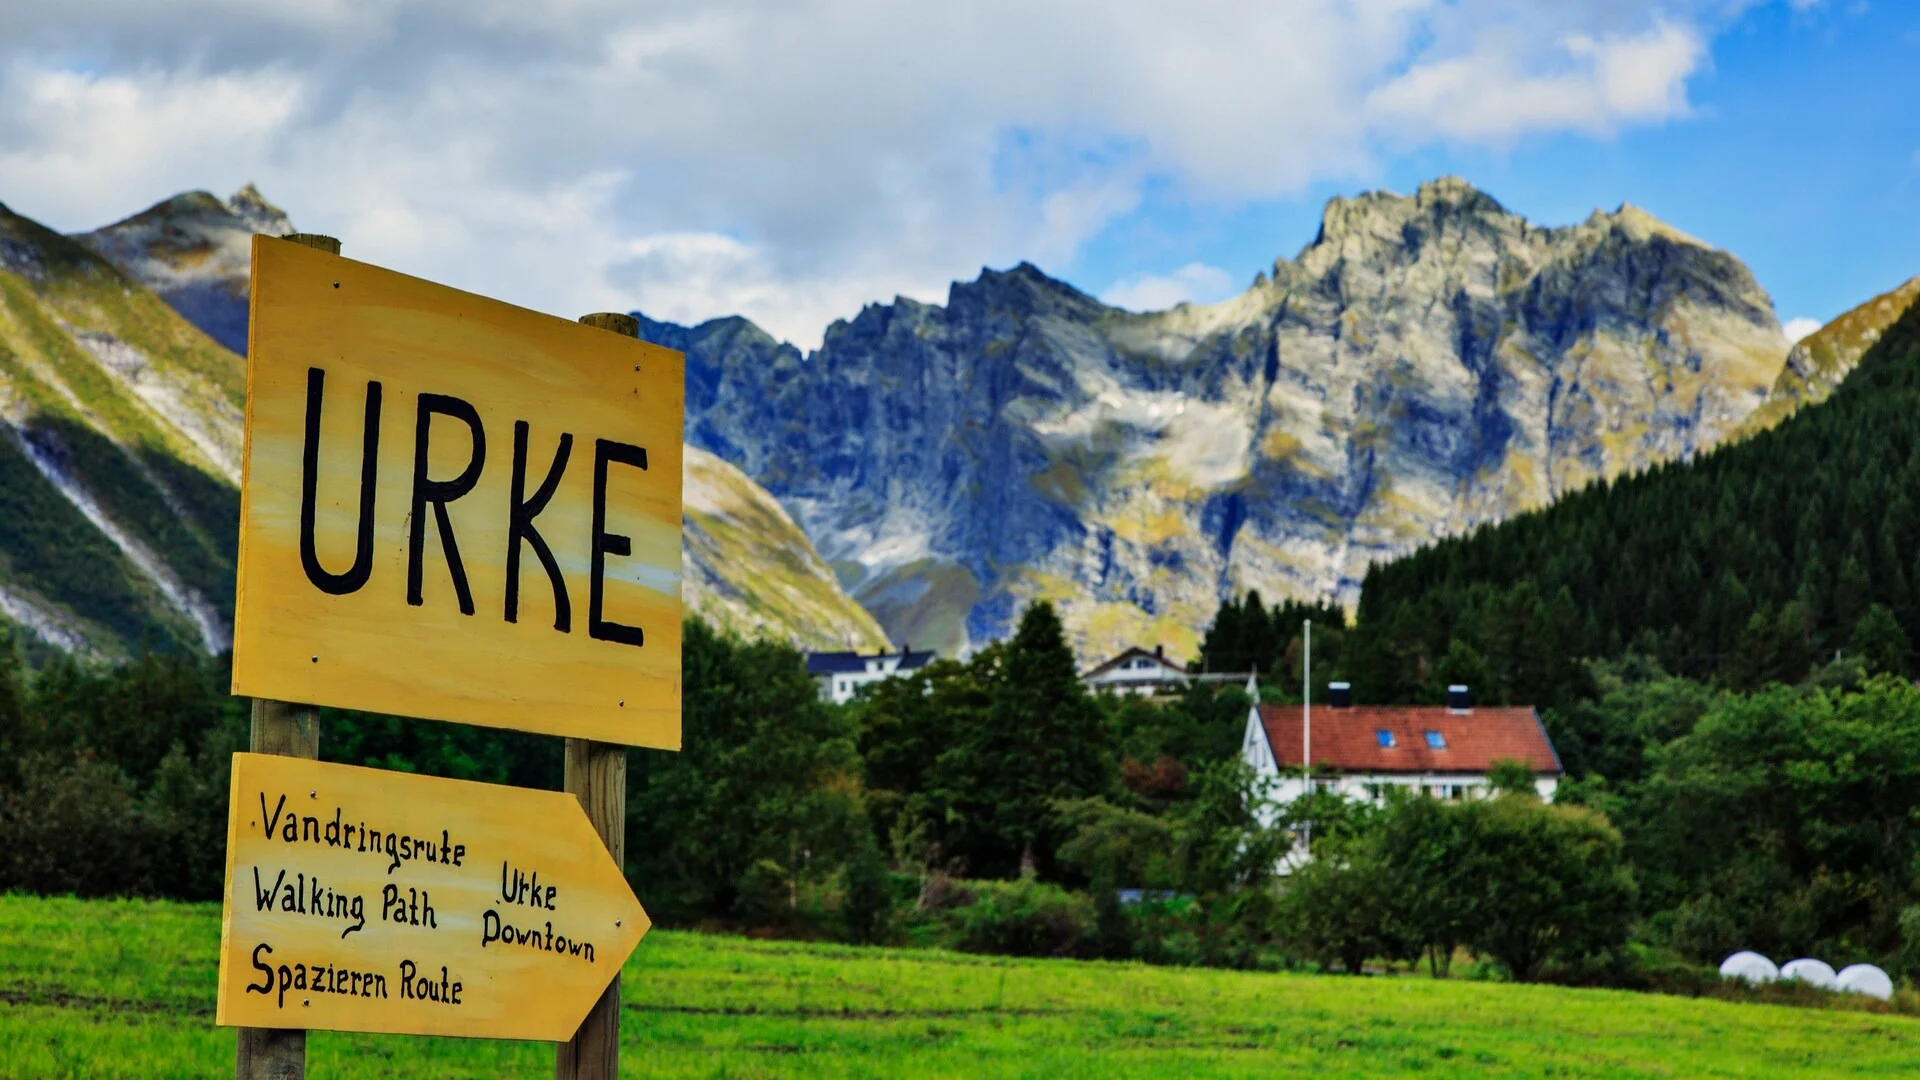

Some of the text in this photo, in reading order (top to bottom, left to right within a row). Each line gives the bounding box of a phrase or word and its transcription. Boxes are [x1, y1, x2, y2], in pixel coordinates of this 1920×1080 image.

[299, 366, 649, 648] URKE
[260, 791, 466, 875] Vandringsrute
[253, 865, 438, 940] Walking Path
[501, 861, 557, 911] Urke
[481, 909, 595, 963] Downtown
[246, 942, 463, 1009] Spazieren Route
